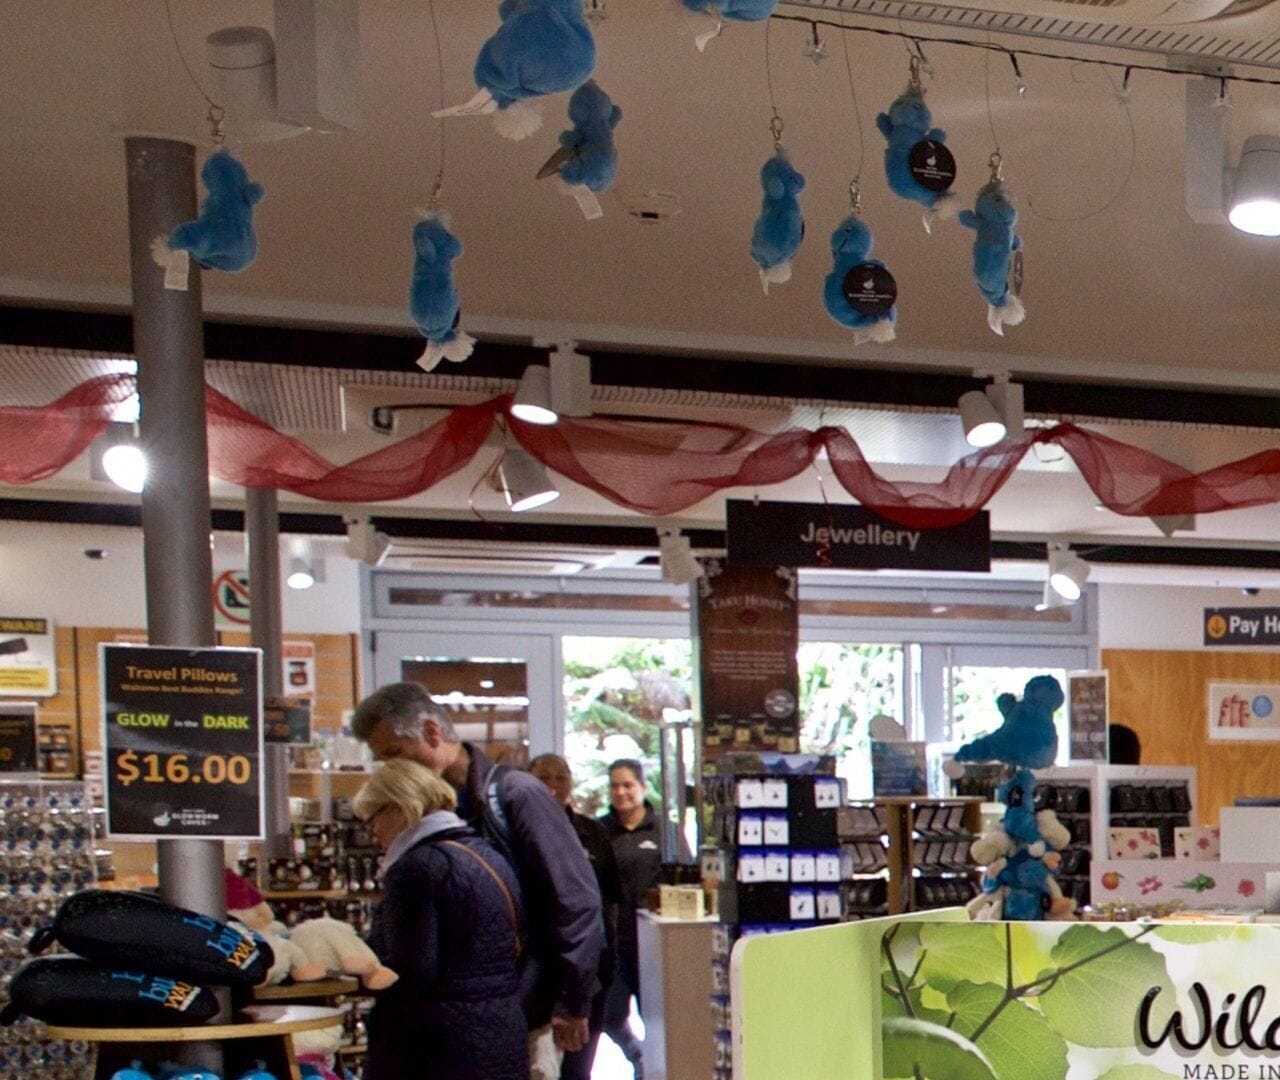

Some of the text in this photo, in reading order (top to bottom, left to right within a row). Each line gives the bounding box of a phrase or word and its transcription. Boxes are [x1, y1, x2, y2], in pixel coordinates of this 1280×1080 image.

[801, 522, 921, 551] Jewellery
[1229, 615, 1260, 638] Pay
[126, 665, 238, 683] Travel Pillows
[117, 713, 171, 727] GLOW
[184, 720, 199, 728] the
[203, 715, 250, 730] DARK
[116, 749, 251, 787] $16.00
[1184, 1064, 1250, 1080] MADE
